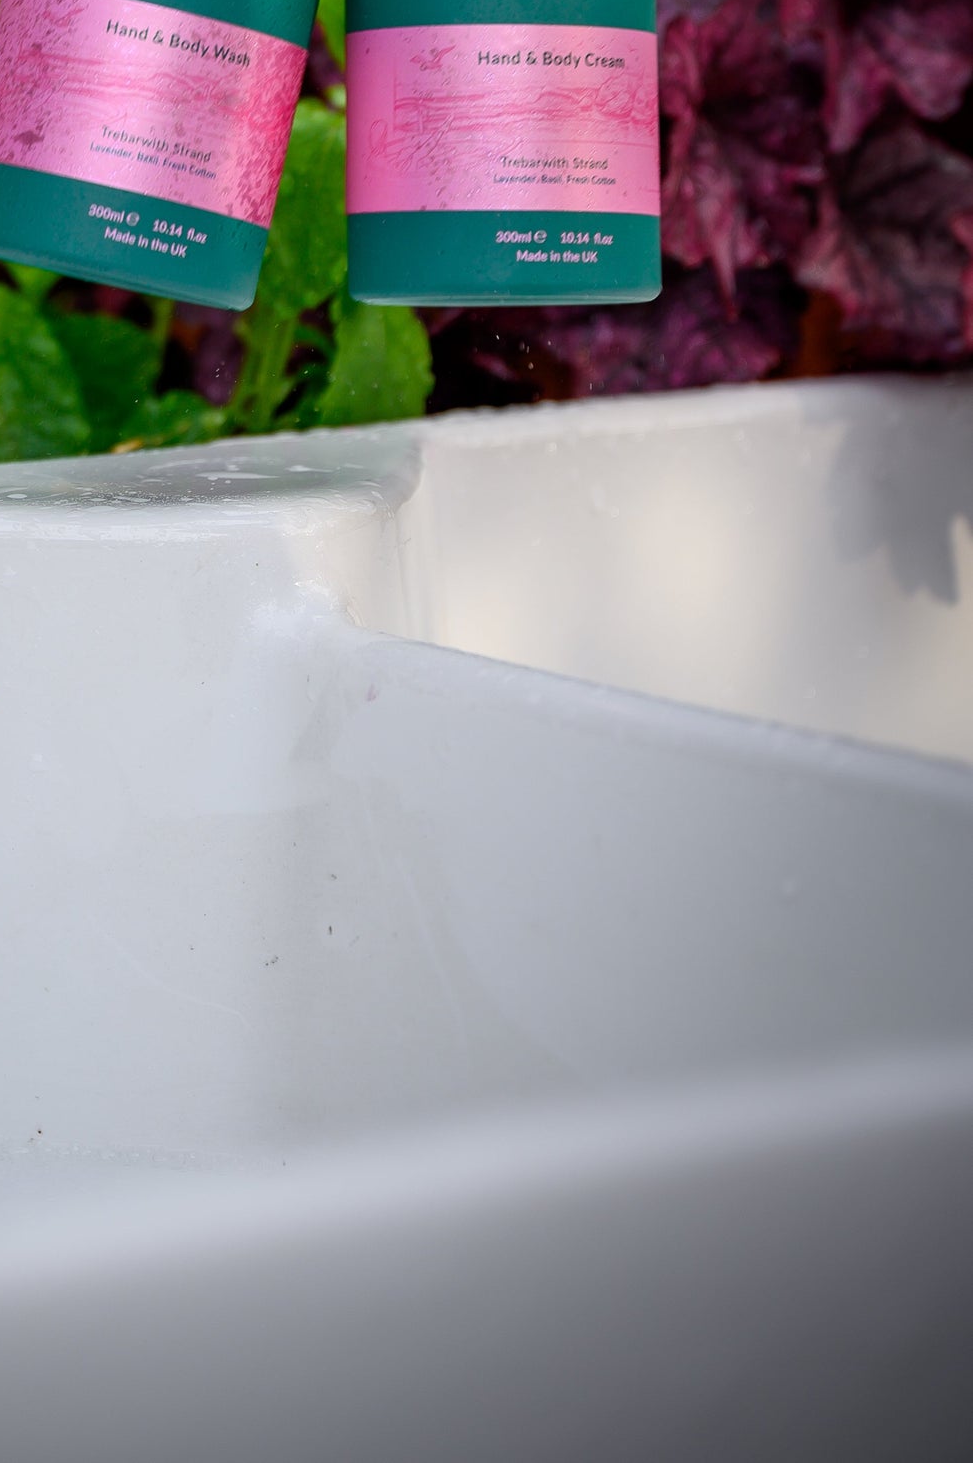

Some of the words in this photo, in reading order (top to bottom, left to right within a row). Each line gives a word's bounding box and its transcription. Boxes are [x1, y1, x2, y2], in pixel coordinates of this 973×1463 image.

[106, 19, 149, 41] Hand
[152, 29, 164, 44] &
[168, 33, 210, 58] Body
[213, 43, 251, 68] Wash
[477, 50, 521, 66] Hand
[525, 50, 538, 66] &
[542, 50, 581, 69] Body
[584, 52, 626, 69] Cream
[102, 125, 169, 153] Trebarwith
[172, 141, 212, 163] Strand
[162, 158, 188, 173] Fresh
[188, 164, 217, 179] Cotton
[500, 156, 569, 169] Trebarwith
[572, 157, 609, 170] Strand
[591, 175, 617, 186] Cotton
[88, 203, 126, 224] 300ml
[152, 218, 184, 238] 10.14
[186, 227, 208, 245] fl.oz
[104, 225, 137, 245] Made
[137, 233, 149, 249] in
[150, 237, 169, 254] the
[170, 242, 188, 258] UK
[495, 229, 532, 244] 300ml
[559, 231, 590, 245] 10.14
[515, 249, 548, 263] Made
[549, 249, 561, 263] in
[562, 249, 580, 263] the
[581, 250, 599, 264] UK
